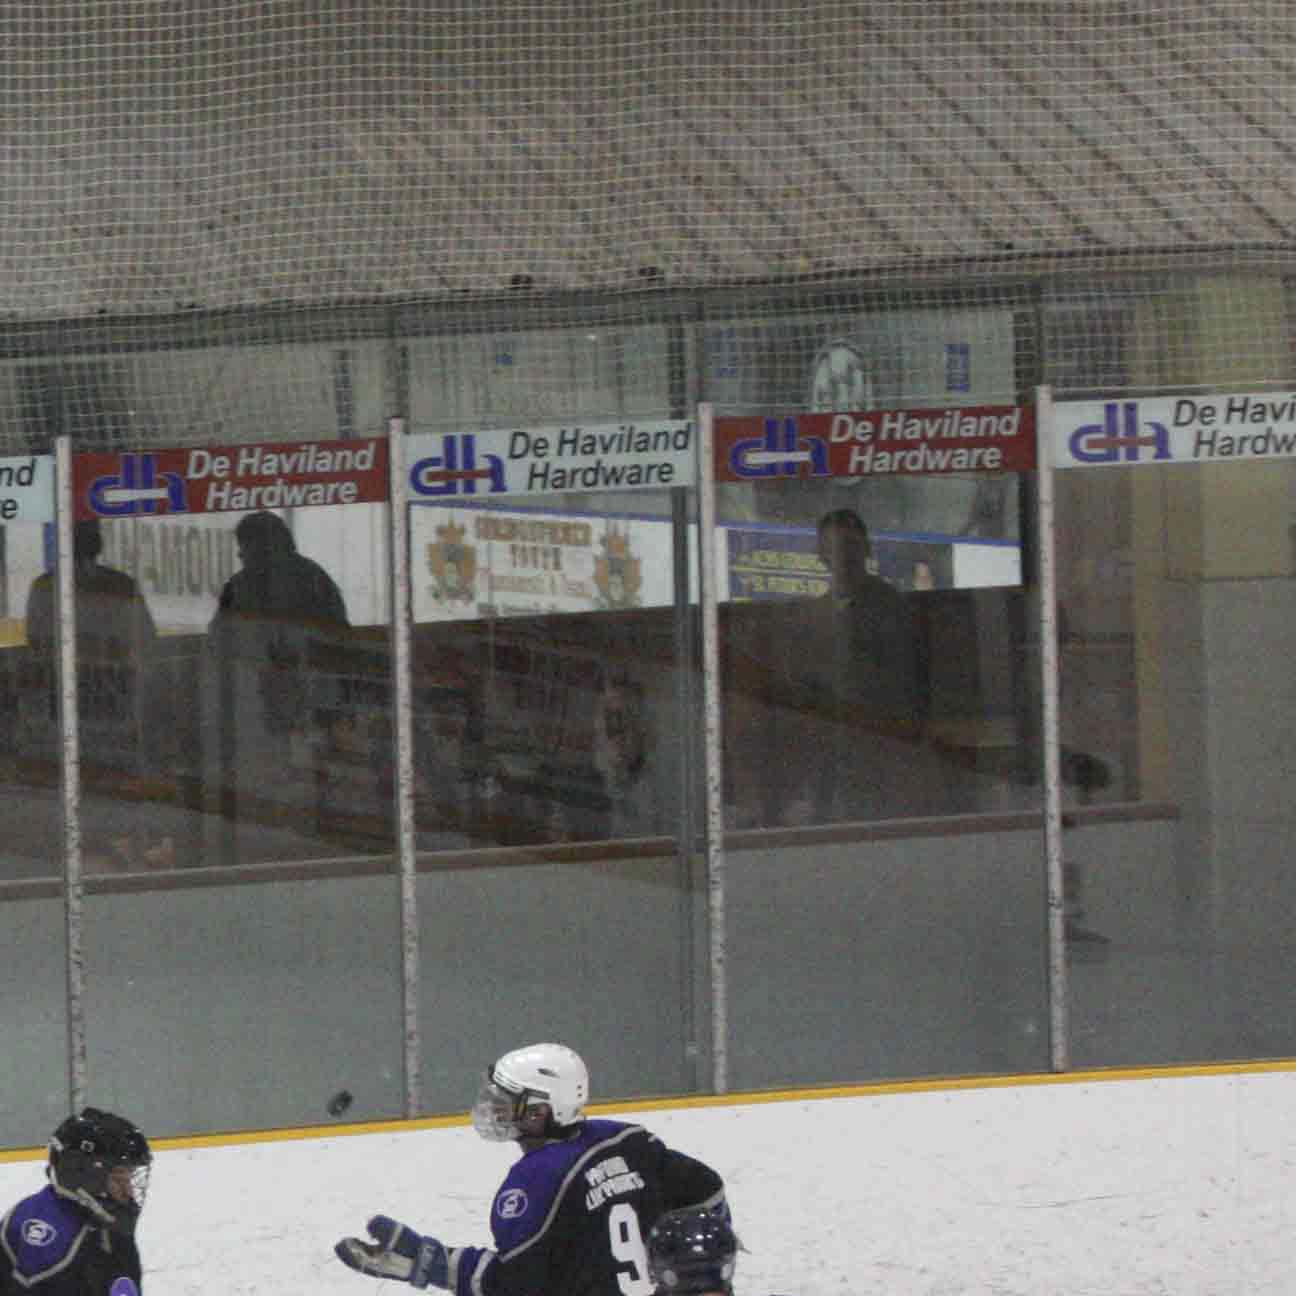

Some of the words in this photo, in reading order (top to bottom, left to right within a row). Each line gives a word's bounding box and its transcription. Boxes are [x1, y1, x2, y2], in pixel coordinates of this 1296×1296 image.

[830, 414, 872, 443] De
[880, 407, 1022, 440] Haviland
[1173, 400, 1216, 427] De
[508, 431, 549, 459] De
[557, 423, 693, 456] Haviland
[187, 450, 231, 479] De
[237, 442, 375, 476] Haviland
[849, 443, 1001, 474] Hardware
[527, 459, 674, 490] Hardware
[205, 479, 357, 510] Hardware
